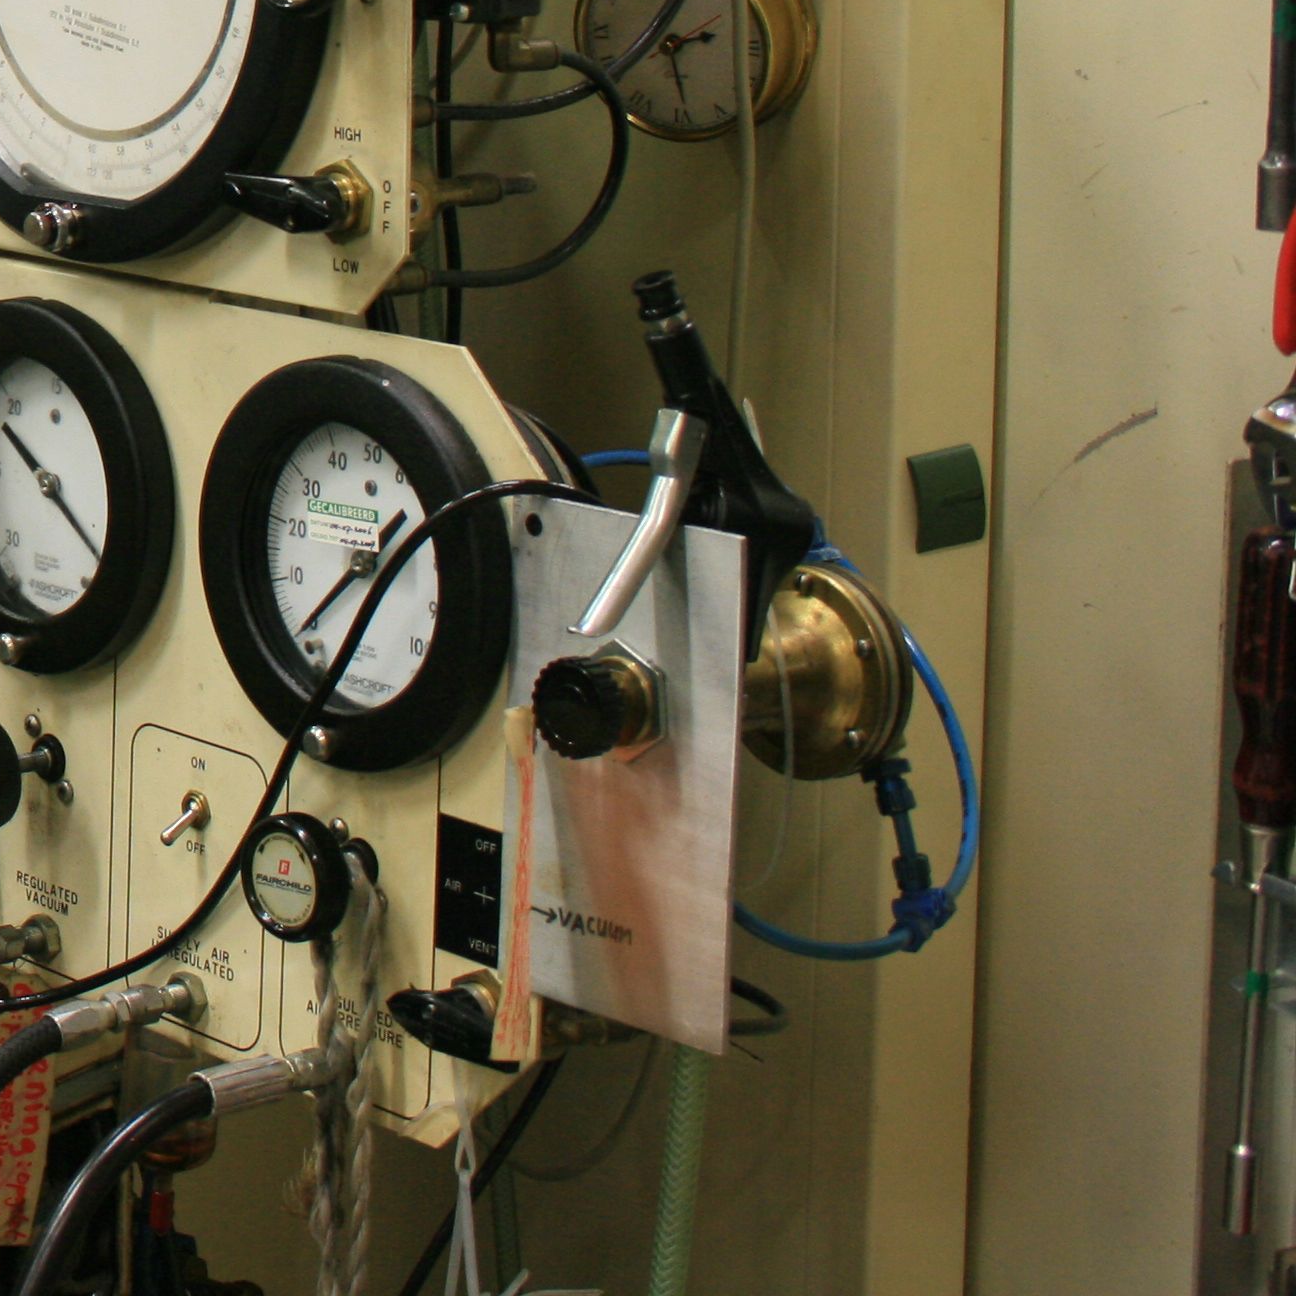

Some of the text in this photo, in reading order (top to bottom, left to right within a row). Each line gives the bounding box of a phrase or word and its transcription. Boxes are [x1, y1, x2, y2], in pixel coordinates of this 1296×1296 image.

[334, 126, 362, 143] HIGH
[332, 258, 360, 274] LOW
[8, 398, 21, 417] 20
[328, 450, 347, 471] 40
[364, 443, 382, 464] 50
[302, 478, 321, 498] 30
[309, 500, 376, 522] GECALIBREERD
[6, 529, 20, 547] 30
[288, 518, 307, 538] 20
[290, 565, 304, 585] 10
[191, 757, 206, 771] ON
[186, 841, 206, 856] OFF
[475, 839, 497, 853] OFF
[16, 870, 79, 905] REGULATED
[256, 872, 312, 893] FAIRCHILD
[444, 878, 462, 892] AIR
[25, 888, 69, 916] VACUUM
[468, 937, 498, 954] VENT
[211, 946, 230, 966] AIR
